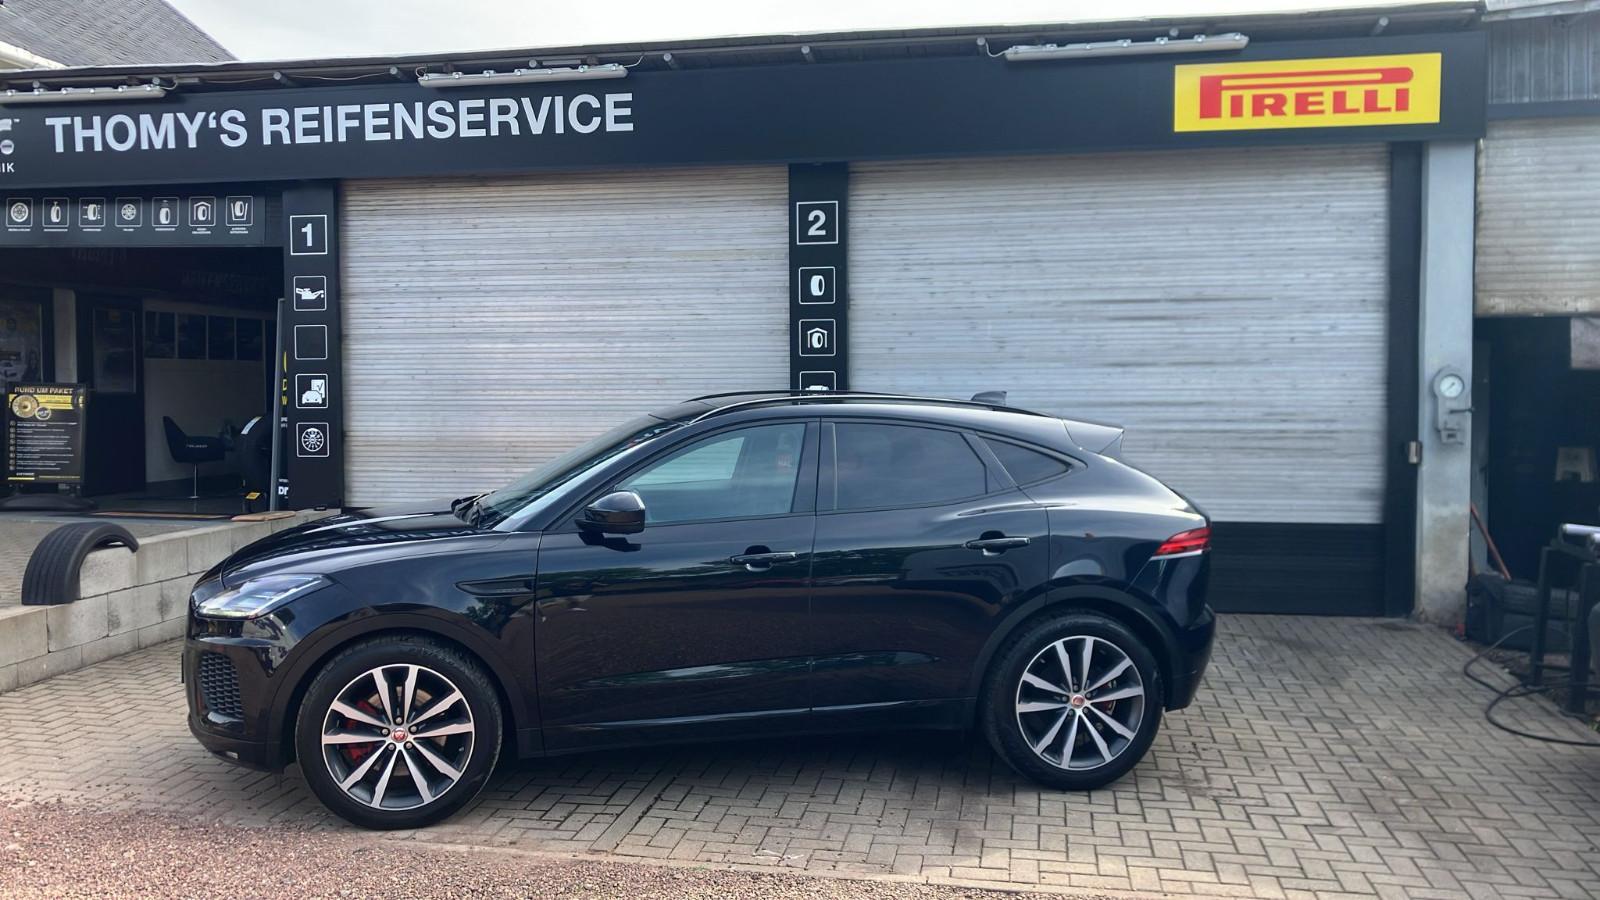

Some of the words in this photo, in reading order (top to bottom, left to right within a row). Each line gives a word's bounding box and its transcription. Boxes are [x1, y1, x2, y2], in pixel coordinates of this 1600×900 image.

[1200, 67, 1413, 119] PIRELLI
[262, 92, 633, 145] REIFENSERVICE
[301, 223, 313, 246] 1
[808, 210, 826, 235] 2
